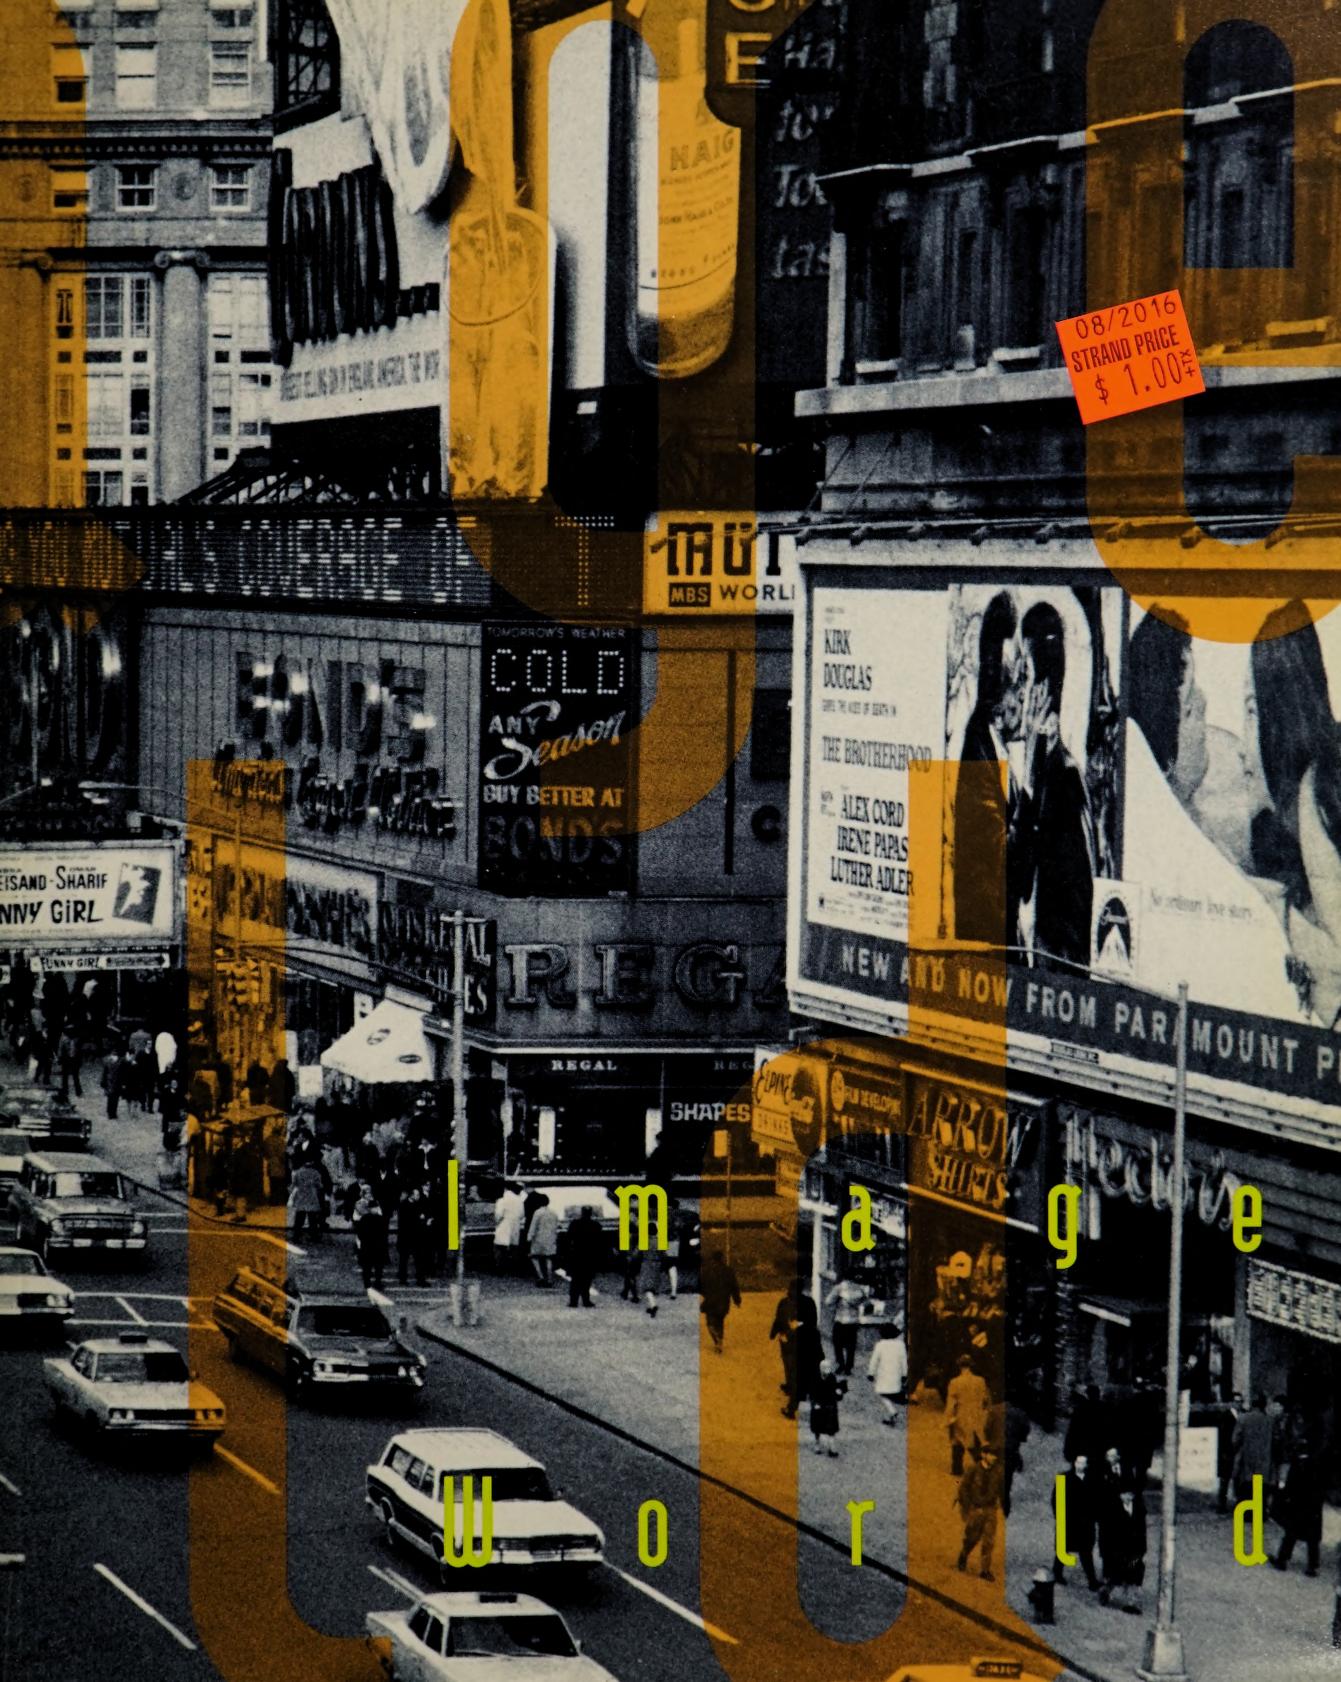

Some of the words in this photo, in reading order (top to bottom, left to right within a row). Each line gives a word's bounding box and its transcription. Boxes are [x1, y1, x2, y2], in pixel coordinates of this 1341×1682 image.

[1075, 295, 1177, 339] 08/2016
[1071, 337, 1132, 373] STRAND
[1134, 324, 1180, 356] PRICE
[1123, 352, 1183, 396] 1.00
[670, 586, 709, 604] MBS
[720, 584, 795, 601] WORL
[487, 627, 565, 640] TOMORROW'S
[570, 627, 626, 640] WEATHER
[824, 628, 851, 655] KIRK
[491, 648, 625, 695] COLD
[823, 662, 873, 691] DOUGLAS
[483, 700, 626, 780] Season
[488, 714, 541, 735] ANY
[822, 735, 842, 763] THE
[844, 738, 932, 773] BROTHERHOOD
[483, 784, 521, 805] BUY
[526, 784, 595, 807] BETTER
[599, 786, 624, 807] AT
[841, 794, 870, 824] ALEX
[872, 798, 905, 828] CORD
[484, 814, 623, 865] BONDS
[837, 825, 871, 856] IRENE
[874, 831, 909, 862] PAPAS
[830, 855, 874, 889] LUTHER
[875, 866, 915, 896] ADLER
[841, 944, 891, 981] NEW
[899, 953, 946, 993] AND
[957, 966, 1013, 1007] NOW
[1025, 981, 1096, 1028] FROM
[551, 1058, 619, 1073] REGAL
[669, 1101, 752, 1123] SHAPES
[905, 1089, 1035, 1168] ARROW
